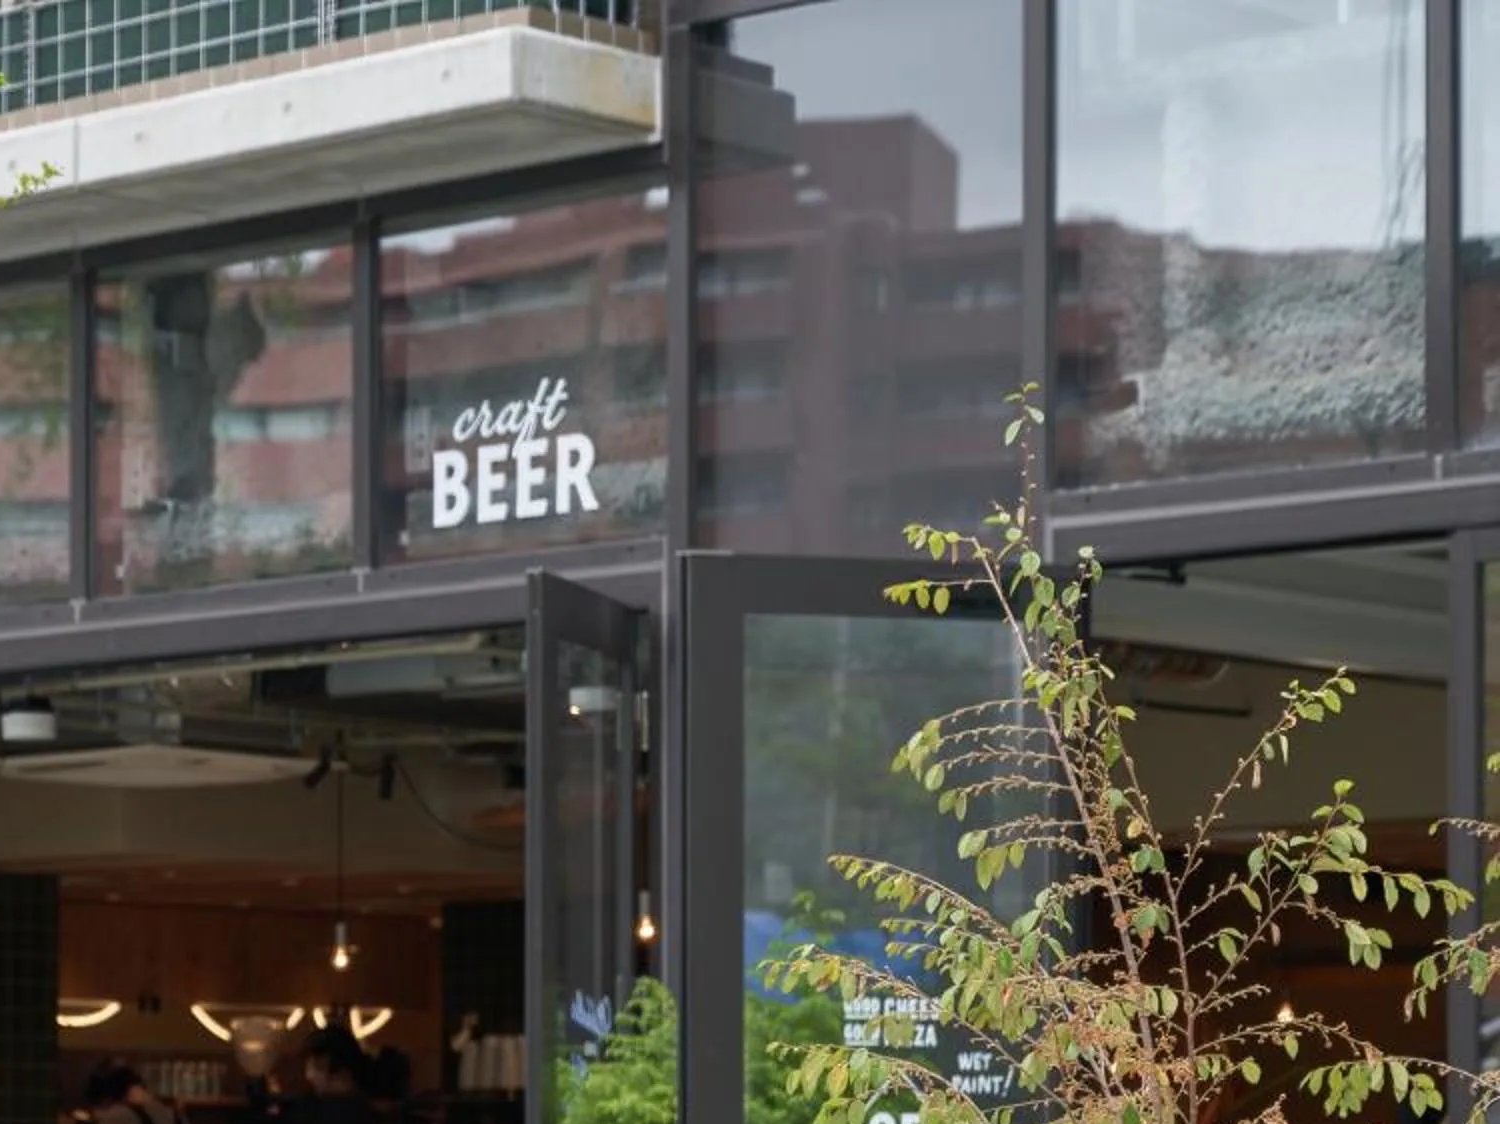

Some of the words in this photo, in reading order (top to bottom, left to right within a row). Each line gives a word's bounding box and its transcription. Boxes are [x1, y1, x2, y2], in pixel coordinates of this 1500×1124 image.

[452, 377, 569, 459] craft
[432, 432, 599, 529] BEER
[957, 1051, 993, 1071] WET
